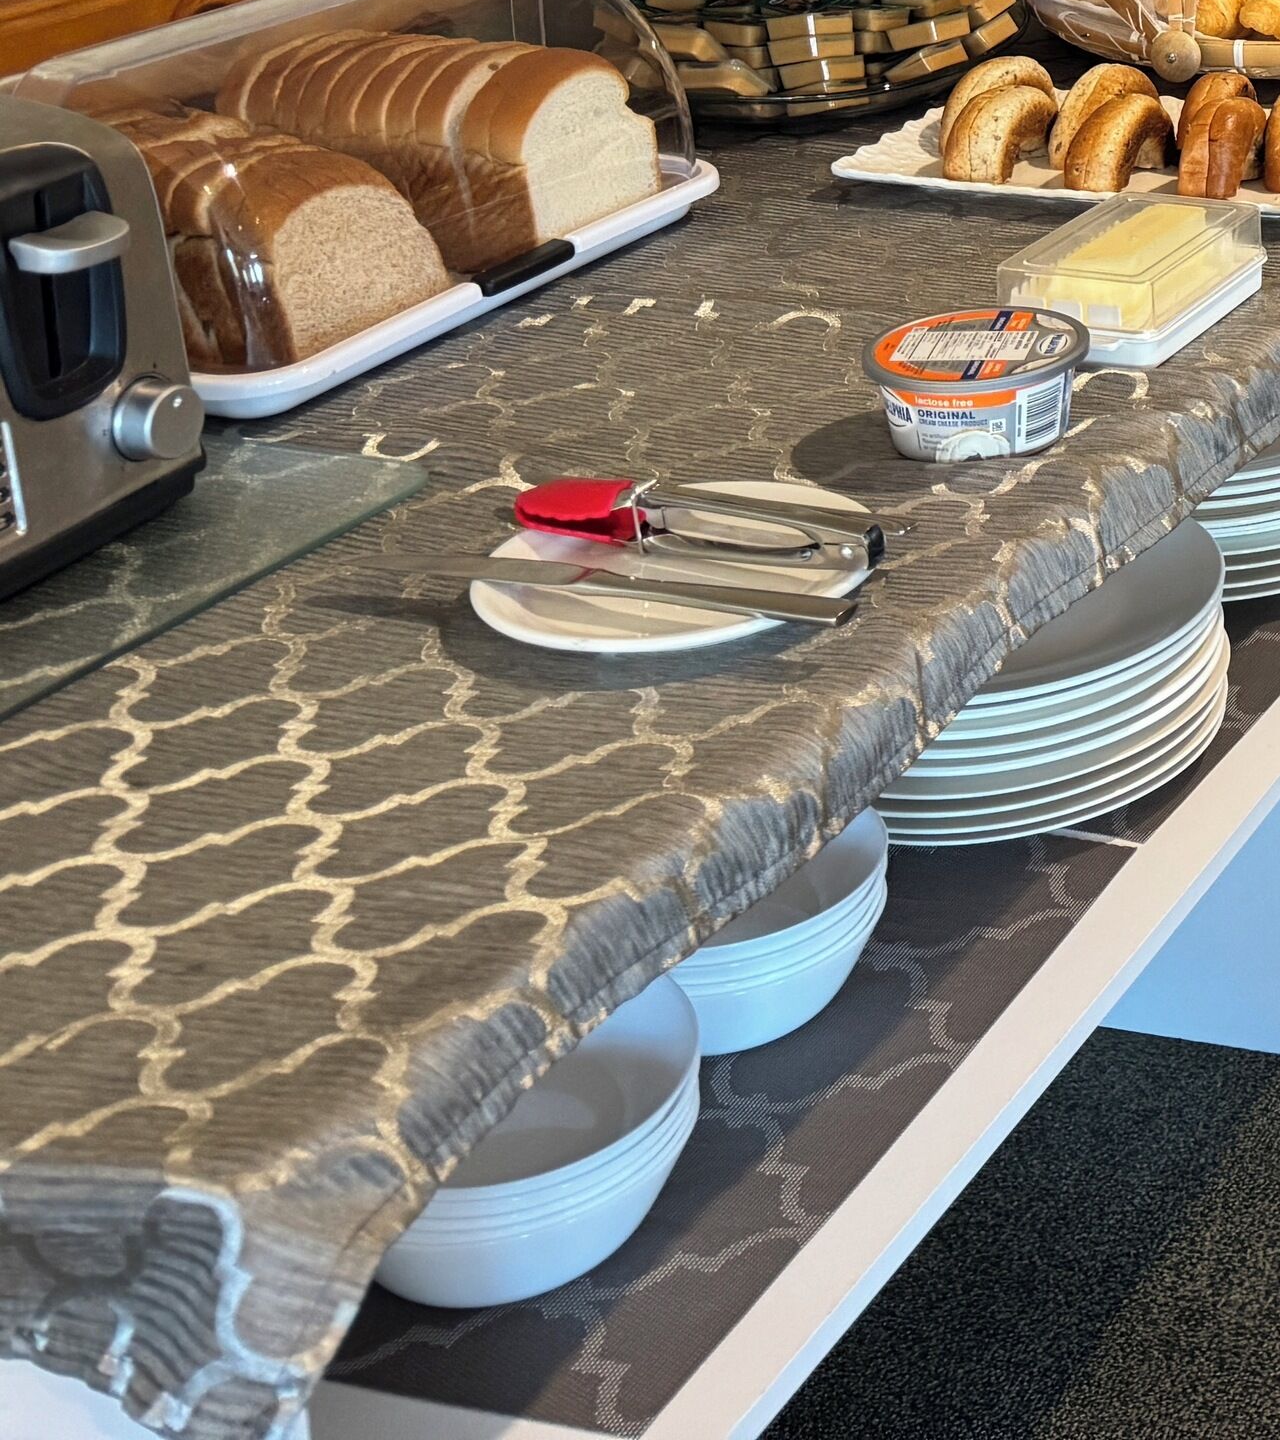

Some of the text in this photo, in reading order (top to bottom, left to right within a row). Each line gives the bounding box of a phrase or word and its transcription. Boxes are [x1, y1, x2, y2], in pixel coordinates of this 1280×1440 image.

[914, 395, 974, 407] lactose free
[917, 409, 976, 420] ORIGINAL
